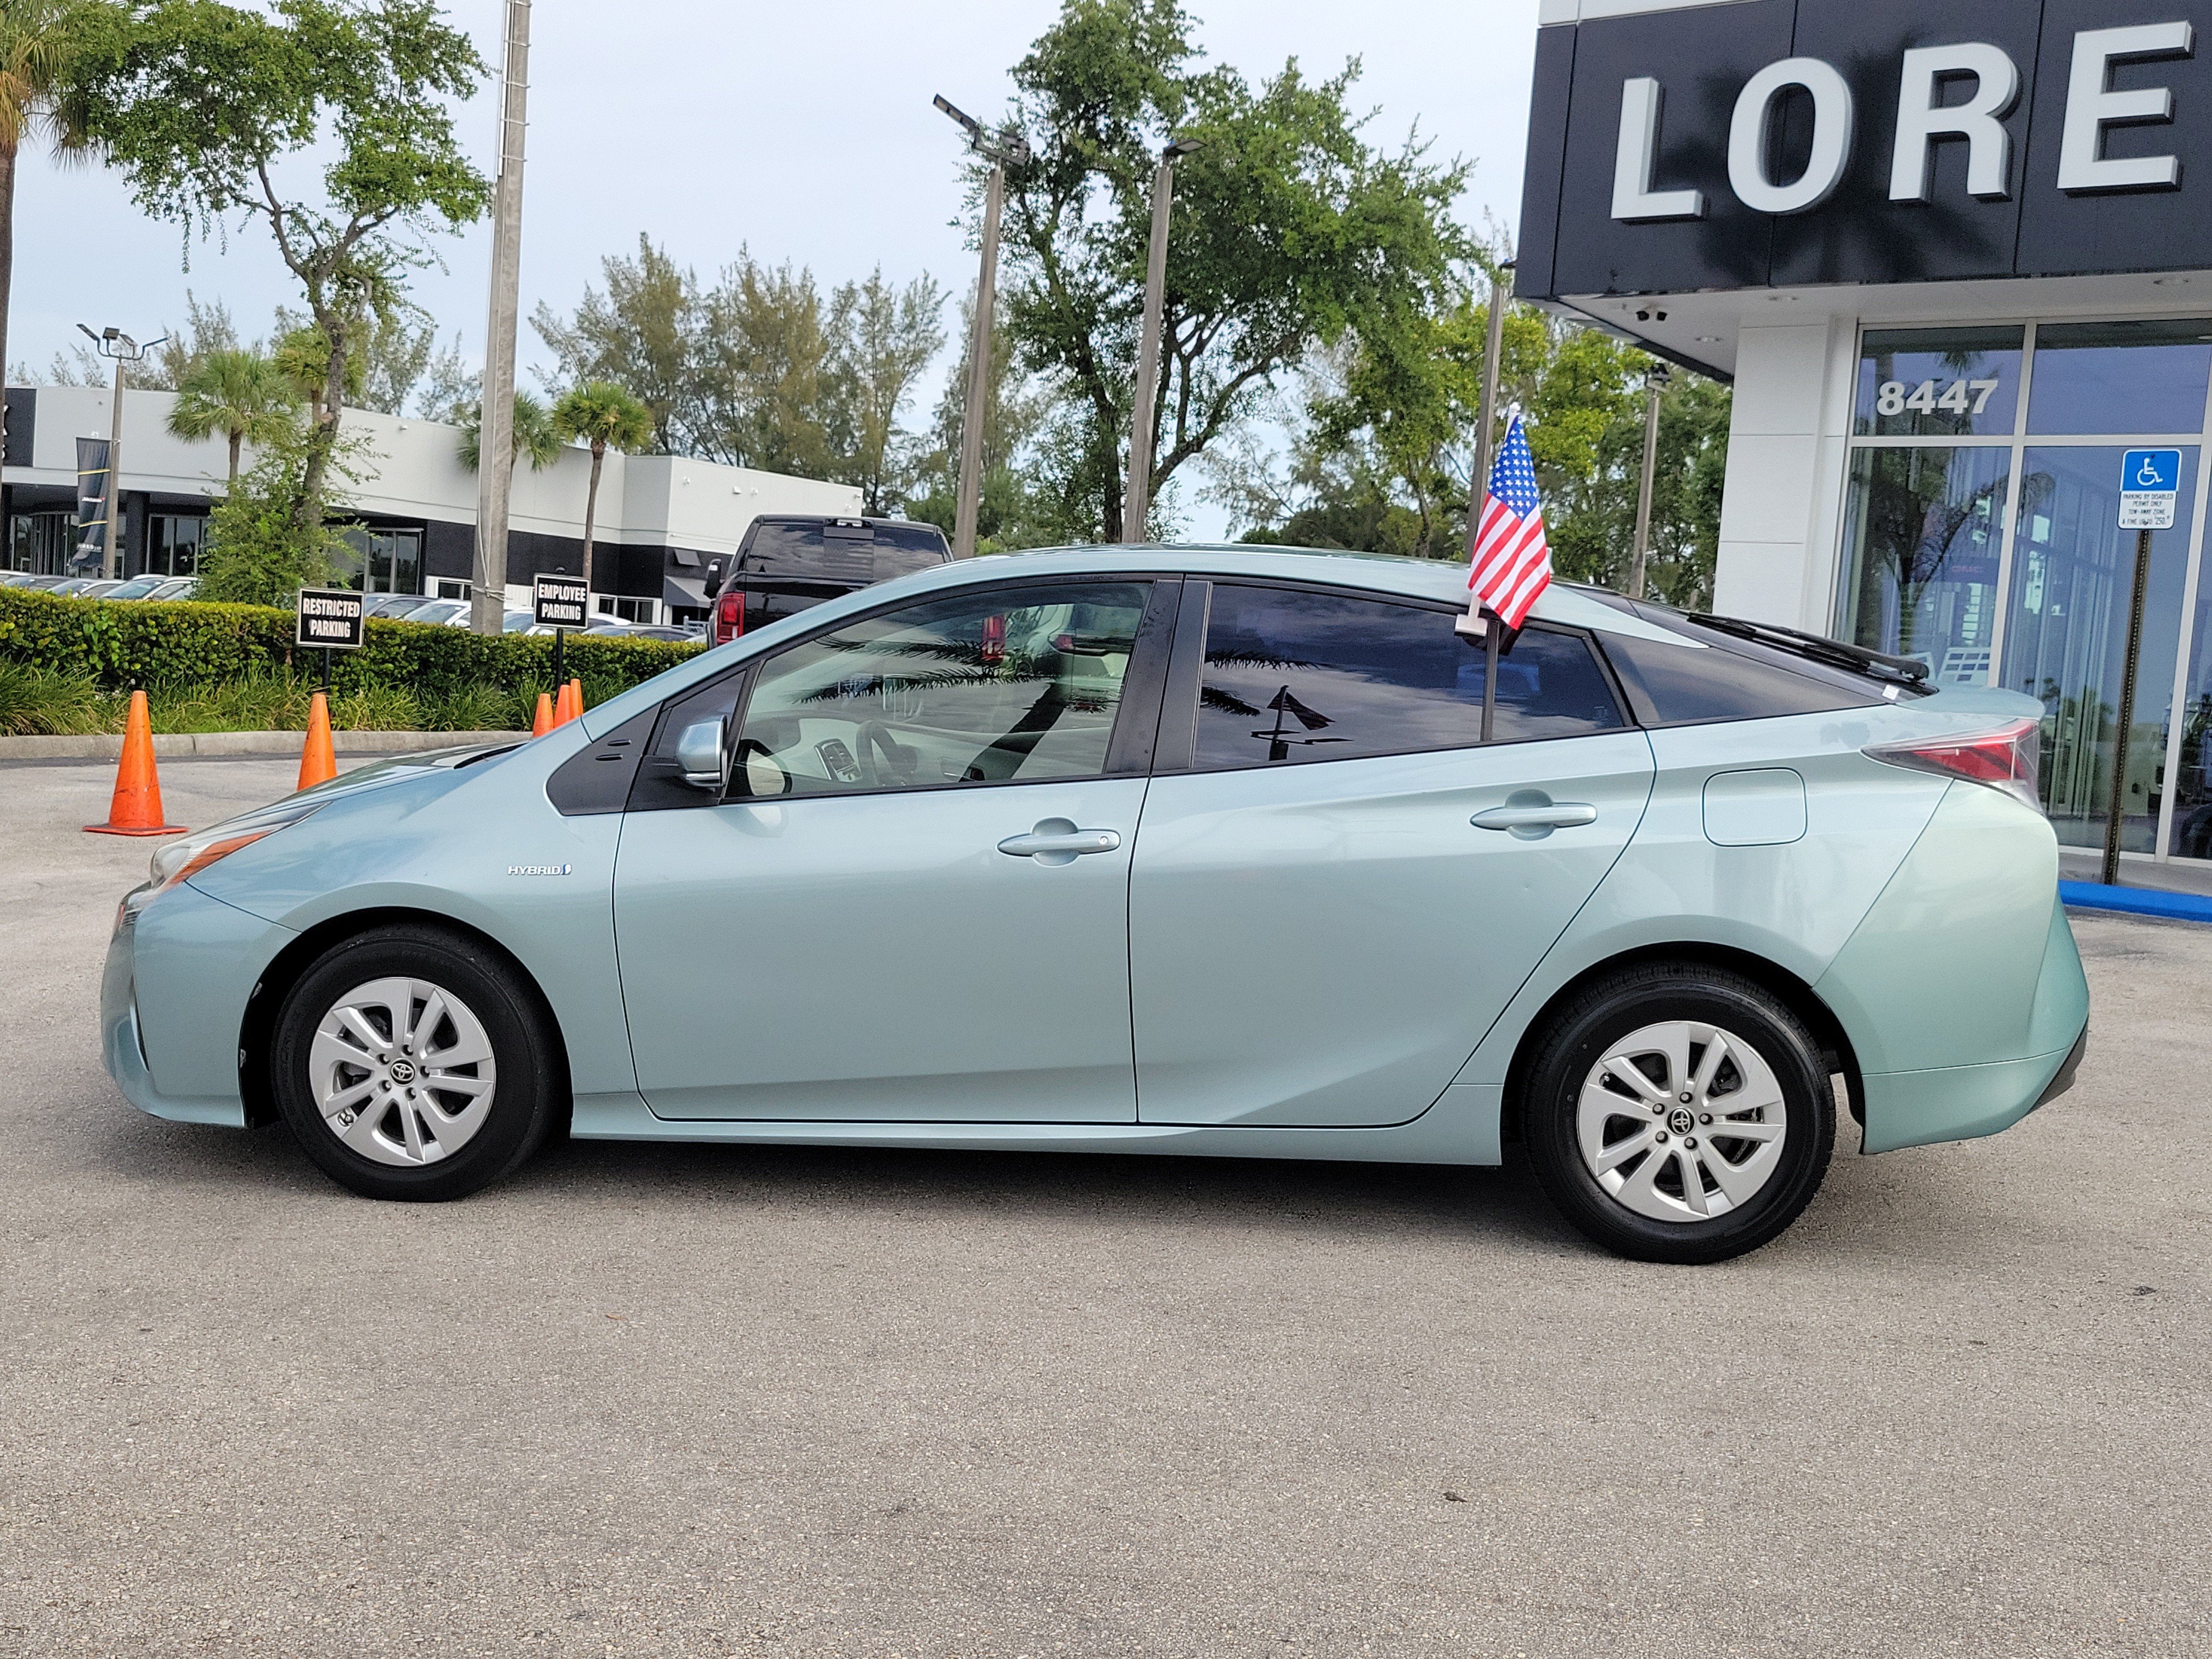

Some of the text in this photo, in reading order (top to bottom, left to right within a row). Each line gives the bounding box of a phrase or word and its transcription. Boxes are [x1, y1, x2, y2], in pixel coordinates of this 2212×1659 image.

[1611, 21, 2192, 219] LORE
[1877, 380, 1998, 415] 8447
[538, 583, 586, 602] EMPLOYEE
[302, 597, 360, 618] RESTRICTED
[541, 602, 582, 620] PARKING
[309, 619, 351, 637] PARKING
[507, 866, 561, 875] HYBRID
